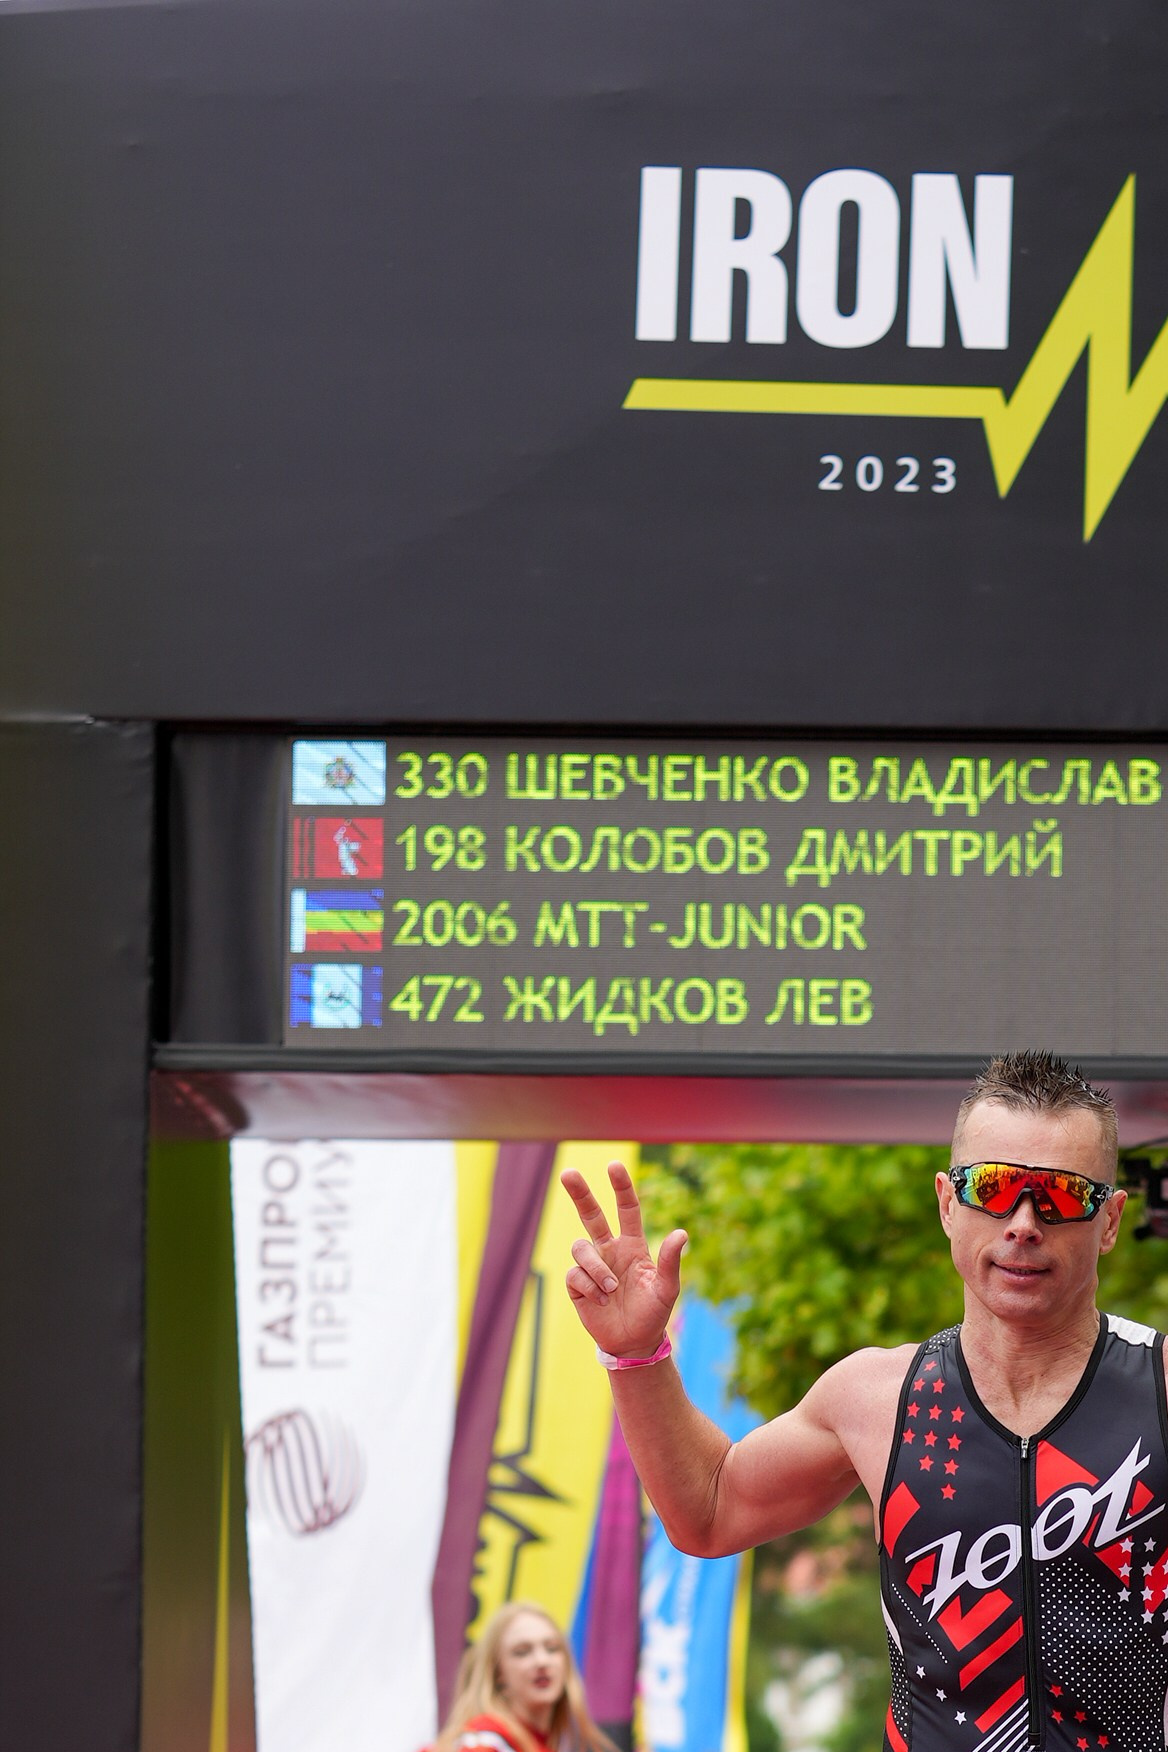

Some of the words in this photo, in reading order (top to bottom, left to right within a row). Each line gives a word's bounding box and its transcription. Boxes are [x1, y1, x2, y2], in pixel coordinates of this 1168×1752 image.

[635, 166, 1014, 350] IRON
[818, 455, 957, 494] 2023
[395, 751, 489, 799] 330
[505, 752, 810, 802] ШЕВЧЕНКО
[827, 755, 1163, 813] ВЛАДИСЛАВ
[396, 823, 486, 871] 198
[505, 824, 770, 874] КОЛОБОВ
[785, 818, 1063, 887] ДМИТРИЙ
[393, 898, 518, 948] 2006
[534, 900, 868, 950] MTT-JUNIOR
[389, 974, 485, 1023] 472
[502, 975, 749, 1035] ЖИДКОВ
[764, 977, 874, 1025] ЛЕВ
[257, 1140, 301, 1369] ГАЗПРО
[306, 1141, 354, 1371] ПРЕМИУ
